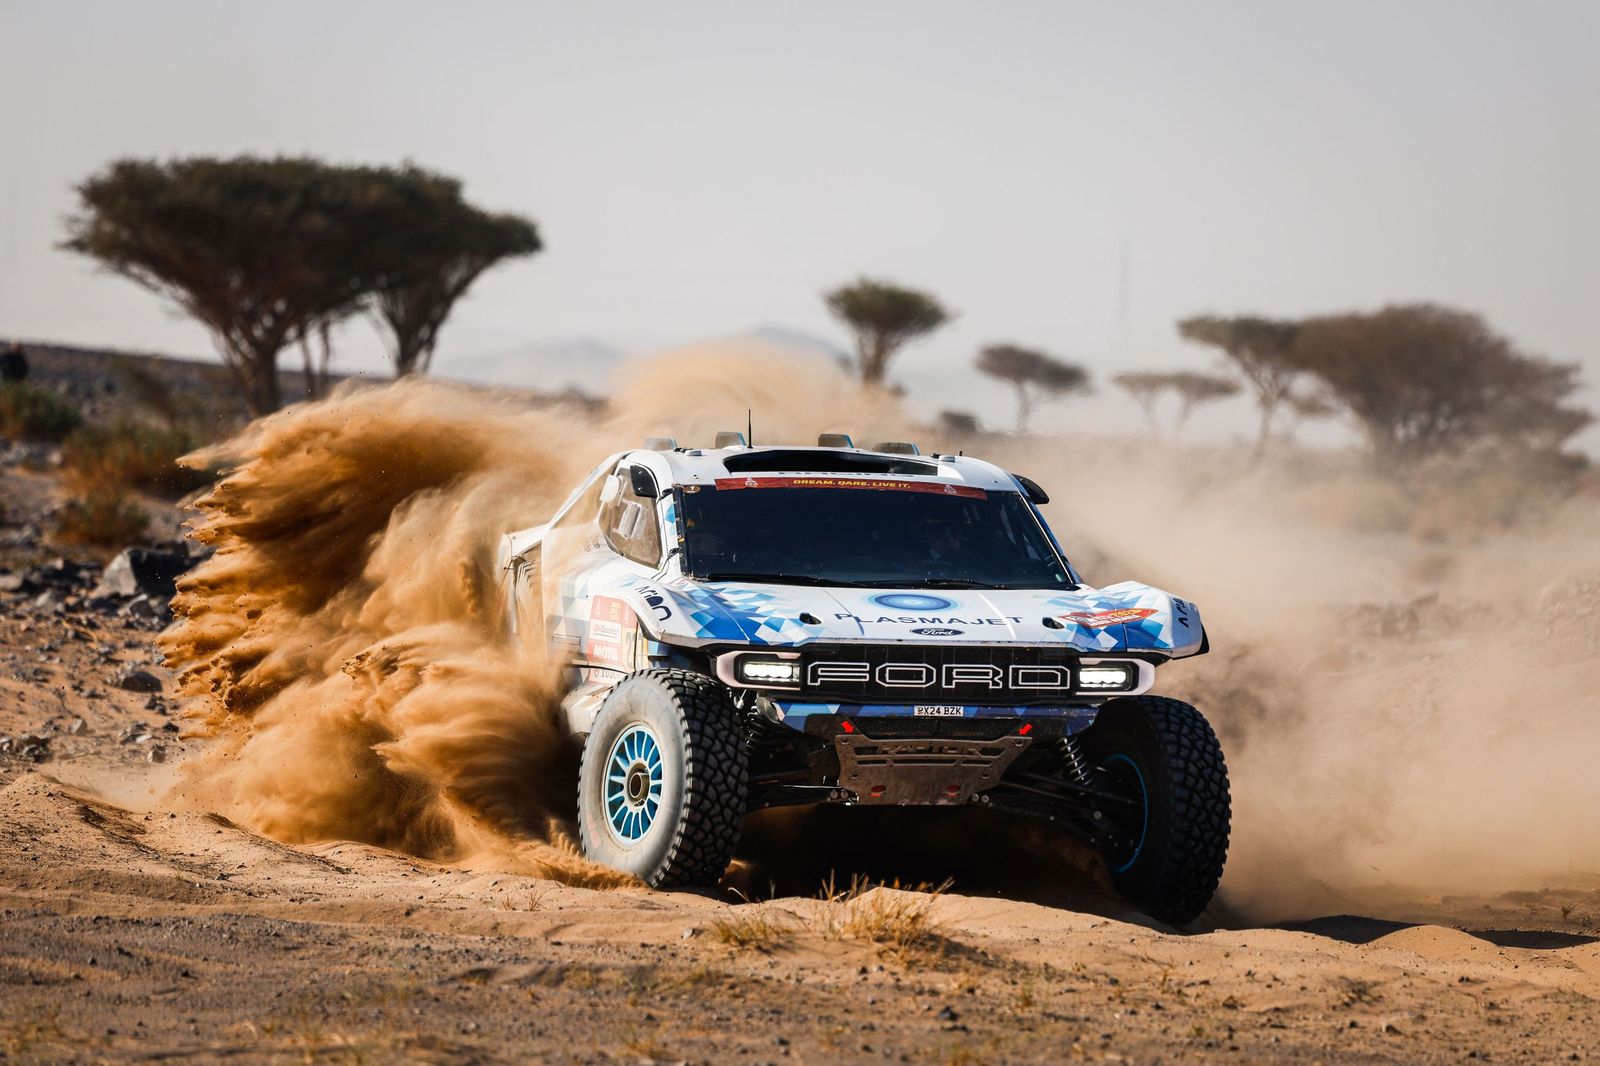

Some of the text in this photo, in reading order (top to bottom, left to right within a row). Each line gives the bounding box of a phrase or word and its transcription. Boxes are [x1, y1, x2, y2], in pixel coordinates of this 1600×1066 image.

[834, 613, 1024, 626] PLASMAJET
[807, 661, 1070, 689] FORD
[943, 706, 962, 715] BZK
